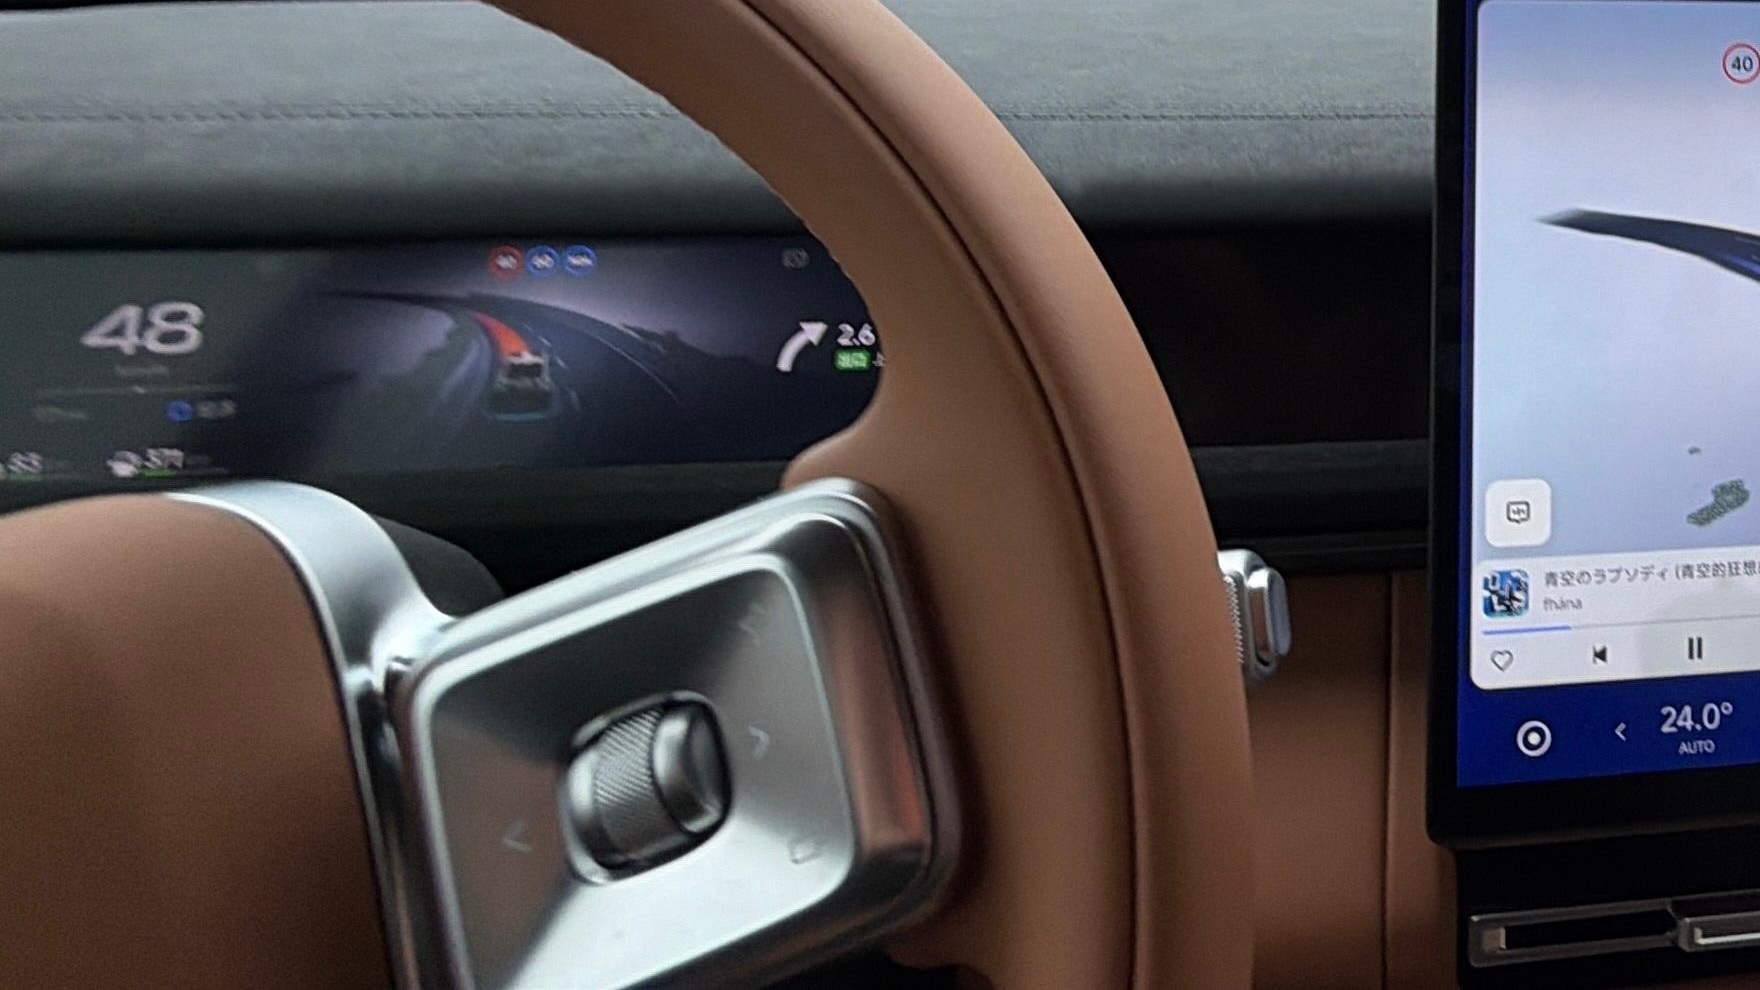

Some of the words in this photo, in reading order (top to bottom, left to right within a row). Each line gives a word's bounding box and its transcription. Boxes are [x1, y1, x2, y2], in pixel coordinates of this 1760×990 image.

[1731, 56, 1754, 73] 40
[80, 300, 206, 355] 48
[836, 323, 876, 347] 2.6
[1660, 701, 1733, 735] 24.0°
[1678, 740, 1715, 755] AUTO
